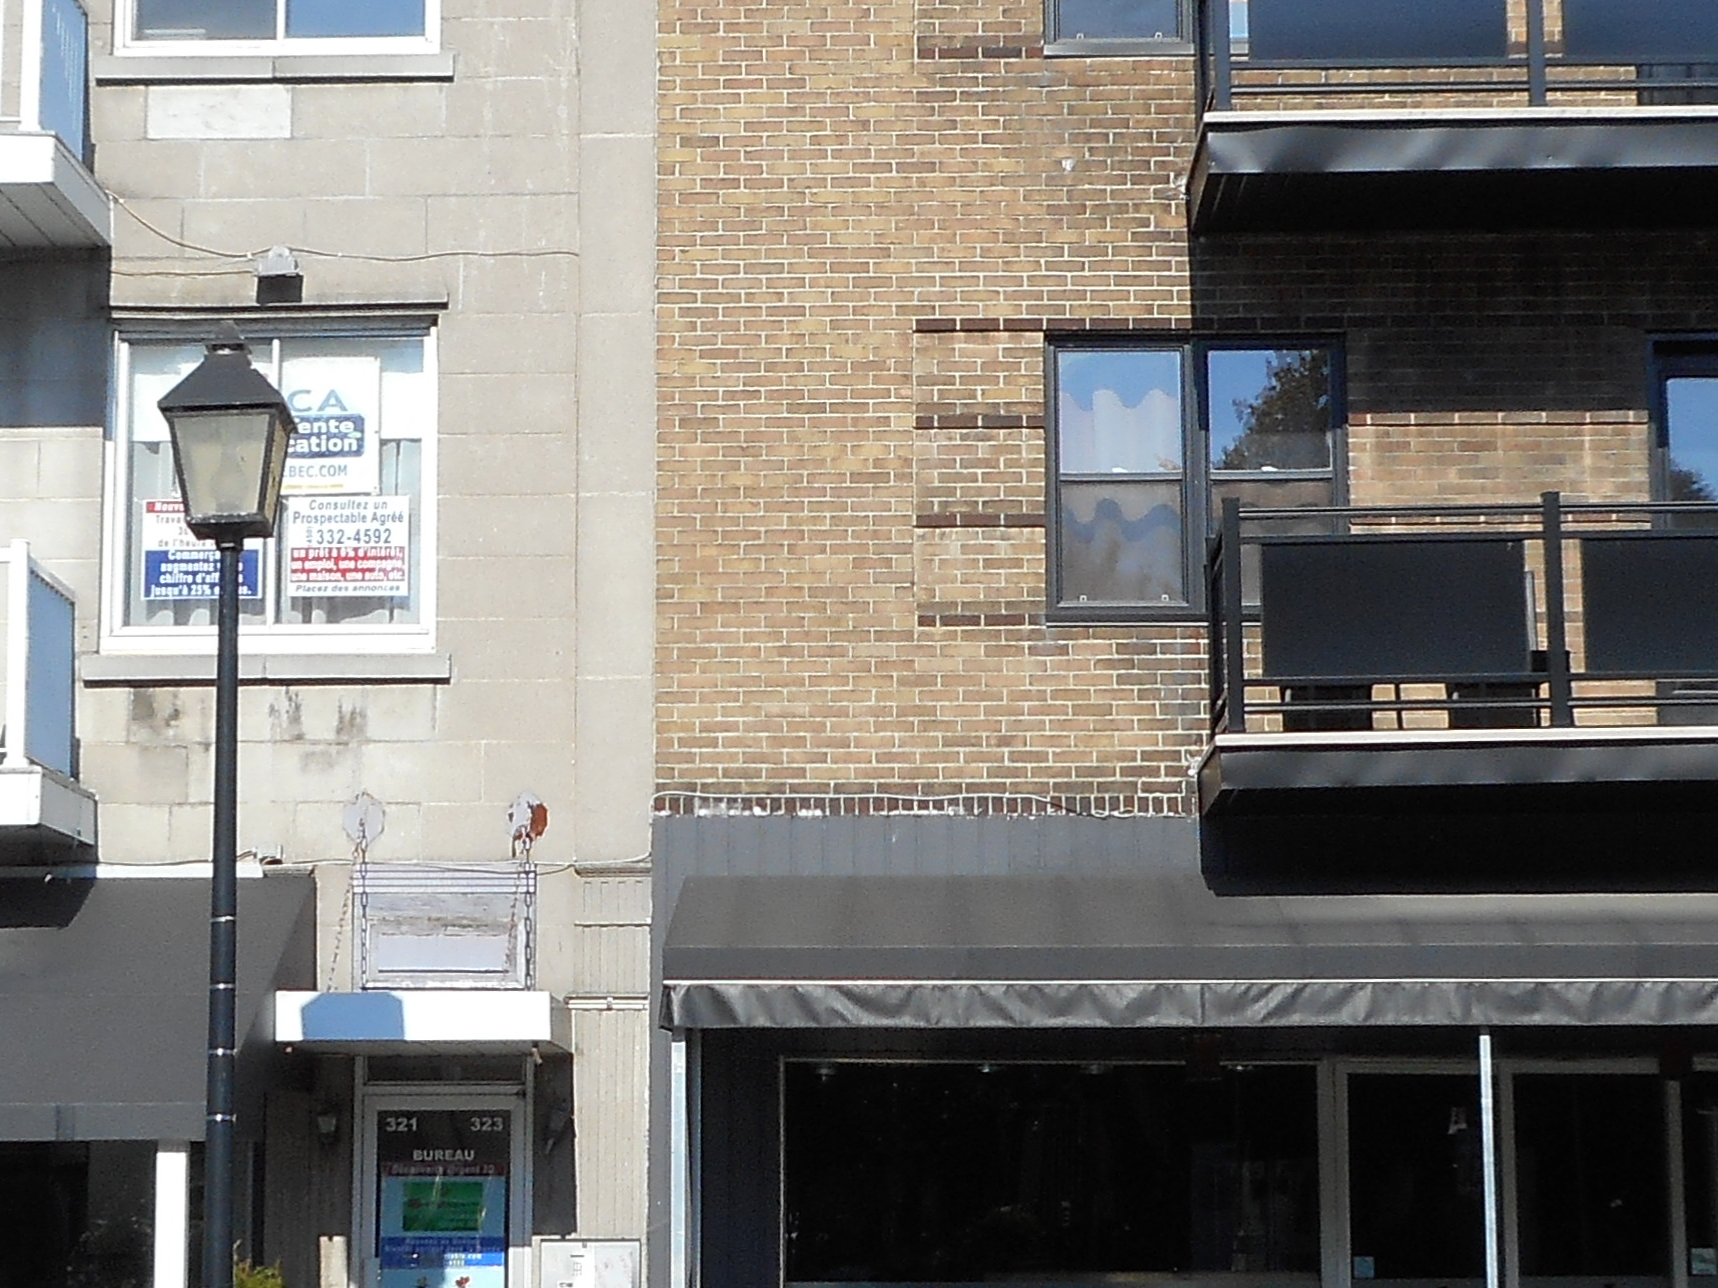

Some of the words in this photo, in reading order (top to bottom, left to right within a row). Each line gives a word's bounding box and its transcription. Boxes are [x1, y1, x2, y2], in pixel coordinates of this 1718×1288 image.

[287, 434, 358, 453] cation
[309, 499, 368, 510] Consultez
[373, 501, 388, 509] un
[292, 511, 367, 525] Prospectable
[371, 511, 404, 526] Agréé
[316, 528, 392, 544] 332-4592
[168, 549, 221, 561] Commerça
[190, 584, 212, 595] 25%
[331, 584, 349, 593] des
[386, 1117, 417, 1131] 321
[470, 1117, 503, 1131] 323
[413, 1149, 475, 1161] BUREAU
